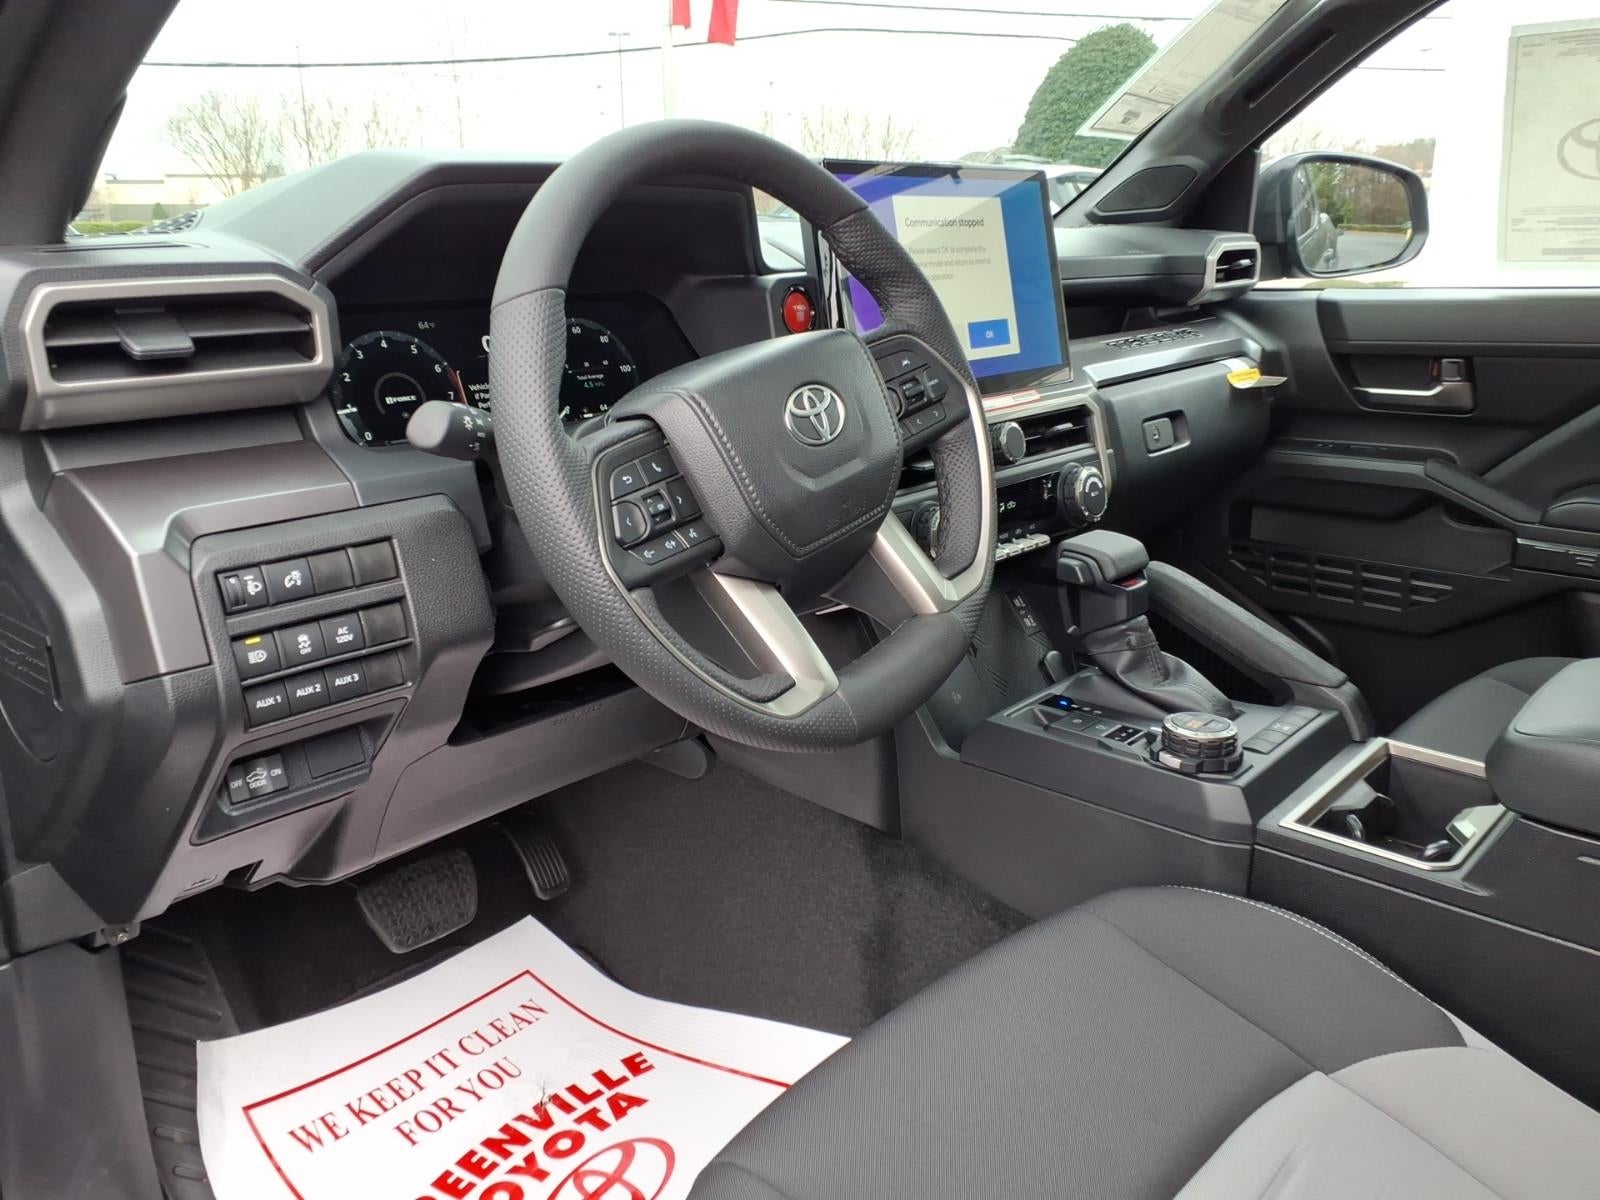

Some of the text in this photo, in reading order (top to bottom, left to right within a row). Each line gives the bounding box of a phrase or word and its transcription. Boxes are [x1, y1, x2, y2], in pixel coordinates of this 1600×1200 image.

[904, 216, 985, 229] Communication stopped
[571, 326, 581, 334] 60
[985, 330, 994, 338] OK
[380, 339, 388, 348] 4
[600, 335, 609, 343] 80
[410, 345, 418, 354] 5
[356, 350, 364, 359] 3
[434, 364, 442, 373] 6
[619, 365, 632, 373] 100
[342, 373, 351, 382] 2
[447, 391, 454, 400] 7
[364, 431, 373, 441] 0
[337, 626, 350, 636] AC
[336, 633, 354, 644] 120V
[300, 646, 312, 655] OFF
[334, 673, 360, 687] AUX 3
[296, 683, 322, 698] AUX 2
[256, 697, 275, 709] AUX
[270, 768, 282, 777] ON
[230, 779, 243, 789] OFF
[288, 998, 550, 1153] WE KEEP IT CLEAN
[393, 1056, 523, 1147] FOR YOU
[416, 1051, 656, 1200] EENVILLE
[478, 1091, 650, 1200] OYOTA
